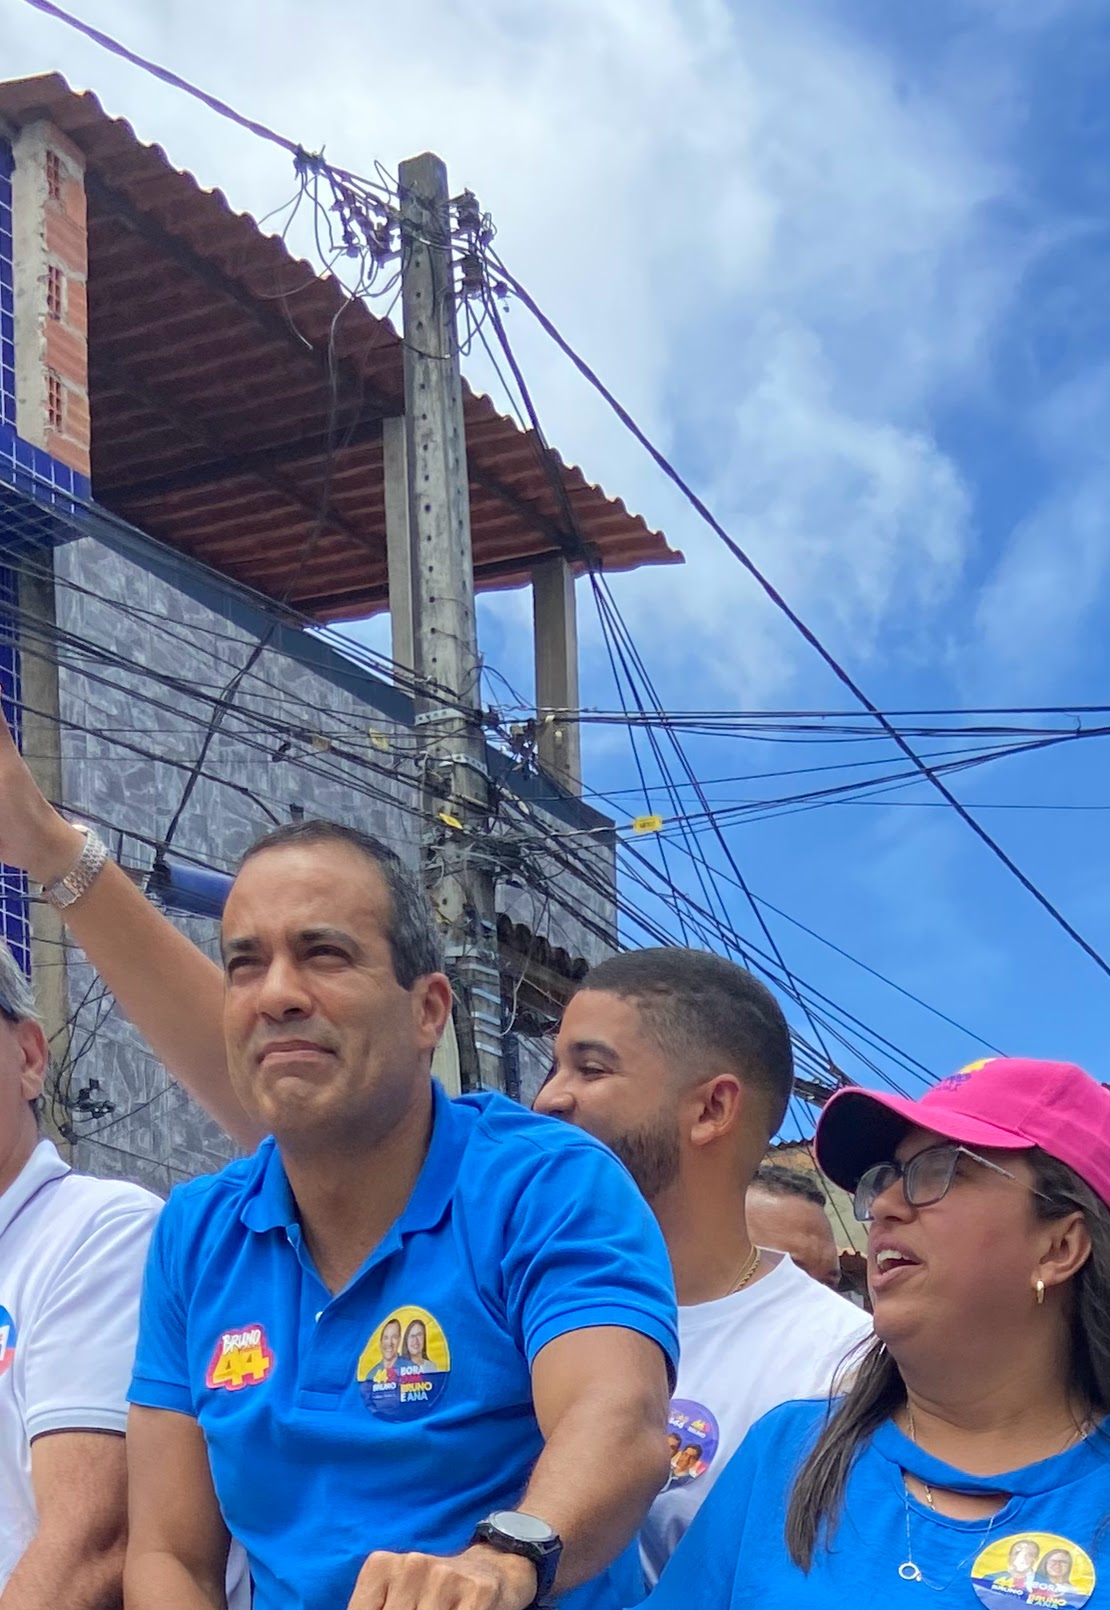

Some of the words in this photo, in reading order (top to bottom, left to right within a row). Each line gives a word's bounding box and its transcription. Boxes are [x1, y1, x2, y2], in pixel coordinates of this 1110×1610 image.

[222, 1329, 262, 1356] BRUNO
[212, 1348, 270, 1386] 44
[400, 1382, 432, 1393] BRUNO
[408, 1391, 428, 1401] ANA
